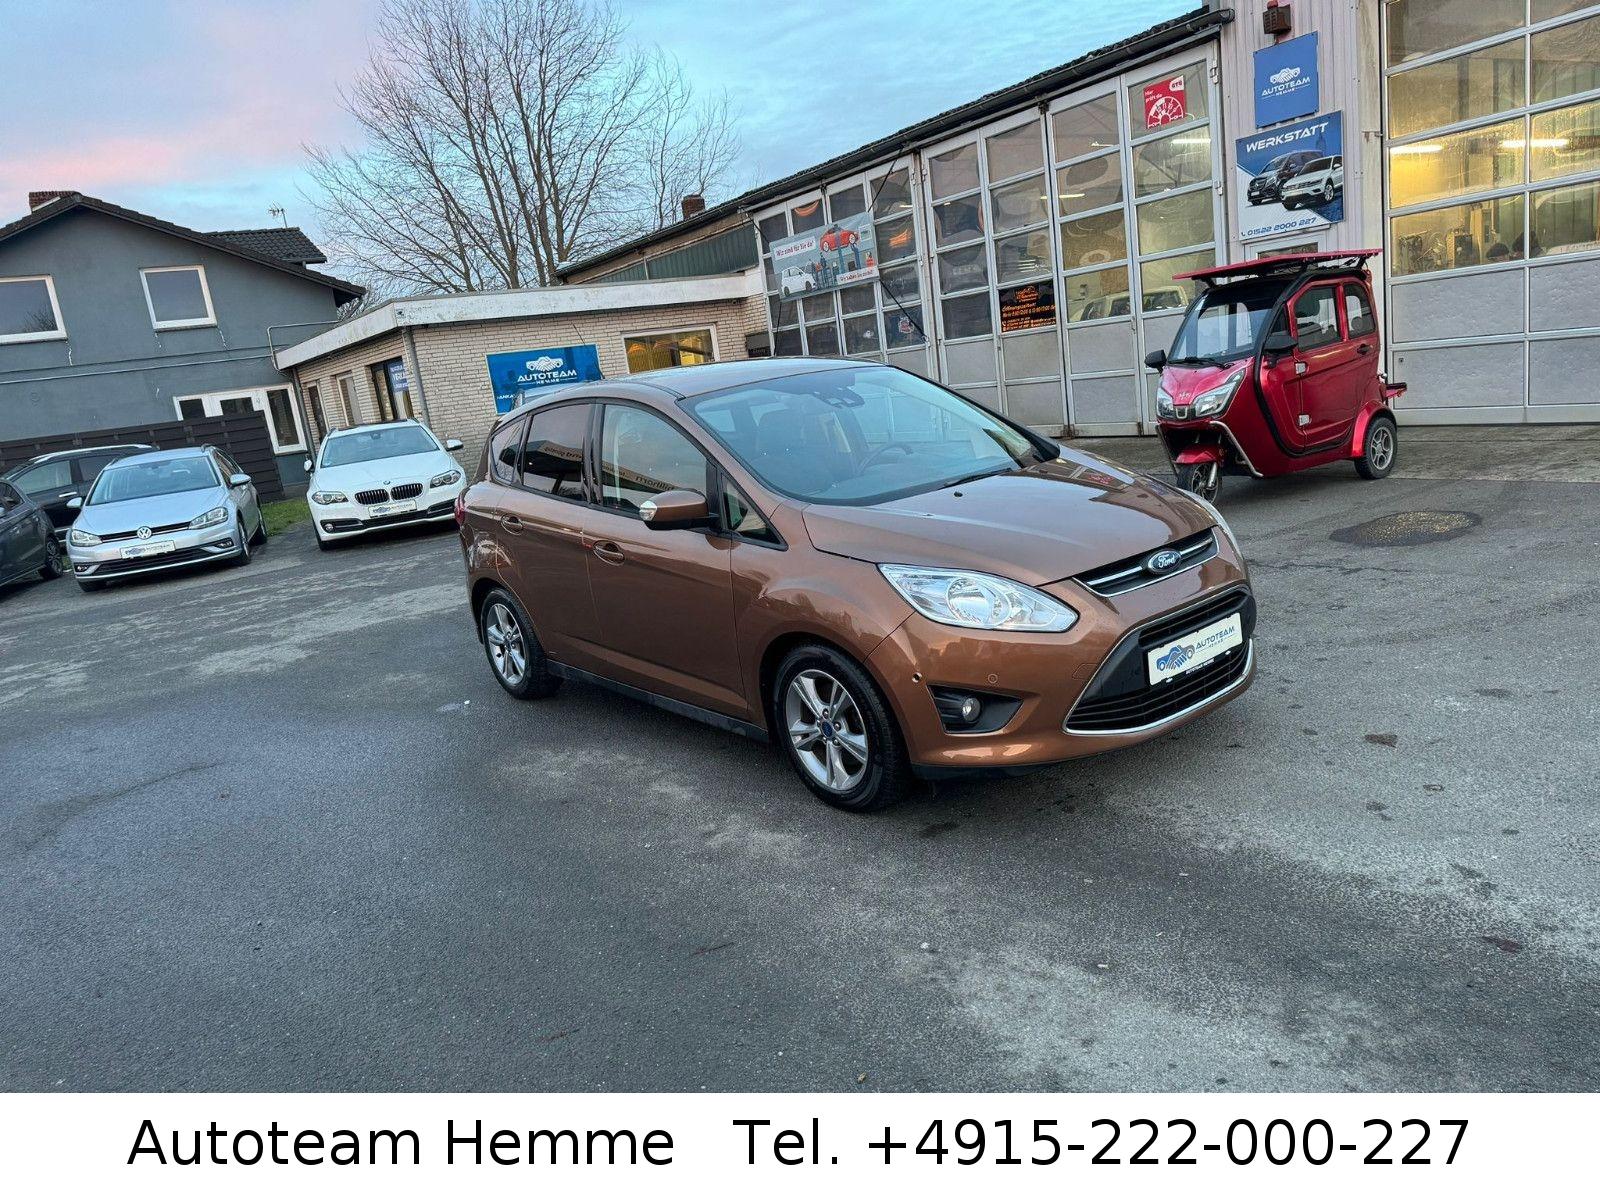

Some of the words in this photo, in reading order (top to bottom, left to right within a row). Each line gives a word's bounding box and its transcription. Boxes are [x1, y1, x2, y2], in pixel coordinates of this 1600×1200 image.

[1261, 76, 1311, 96] AUTOTEAM
[1246, 121, 1329, 153] WERKSTATT
[1247, 226, 1273, 236] 01522
[1273, 221, 1298, 232] 2000
[1298, 217, 1318, 227] 227
[517, 369, 578, 382] AUTOTEAM
[1157, 553, 1176, 569] Ford
[1195, 627, 1235, 648] AUTOTEAM
